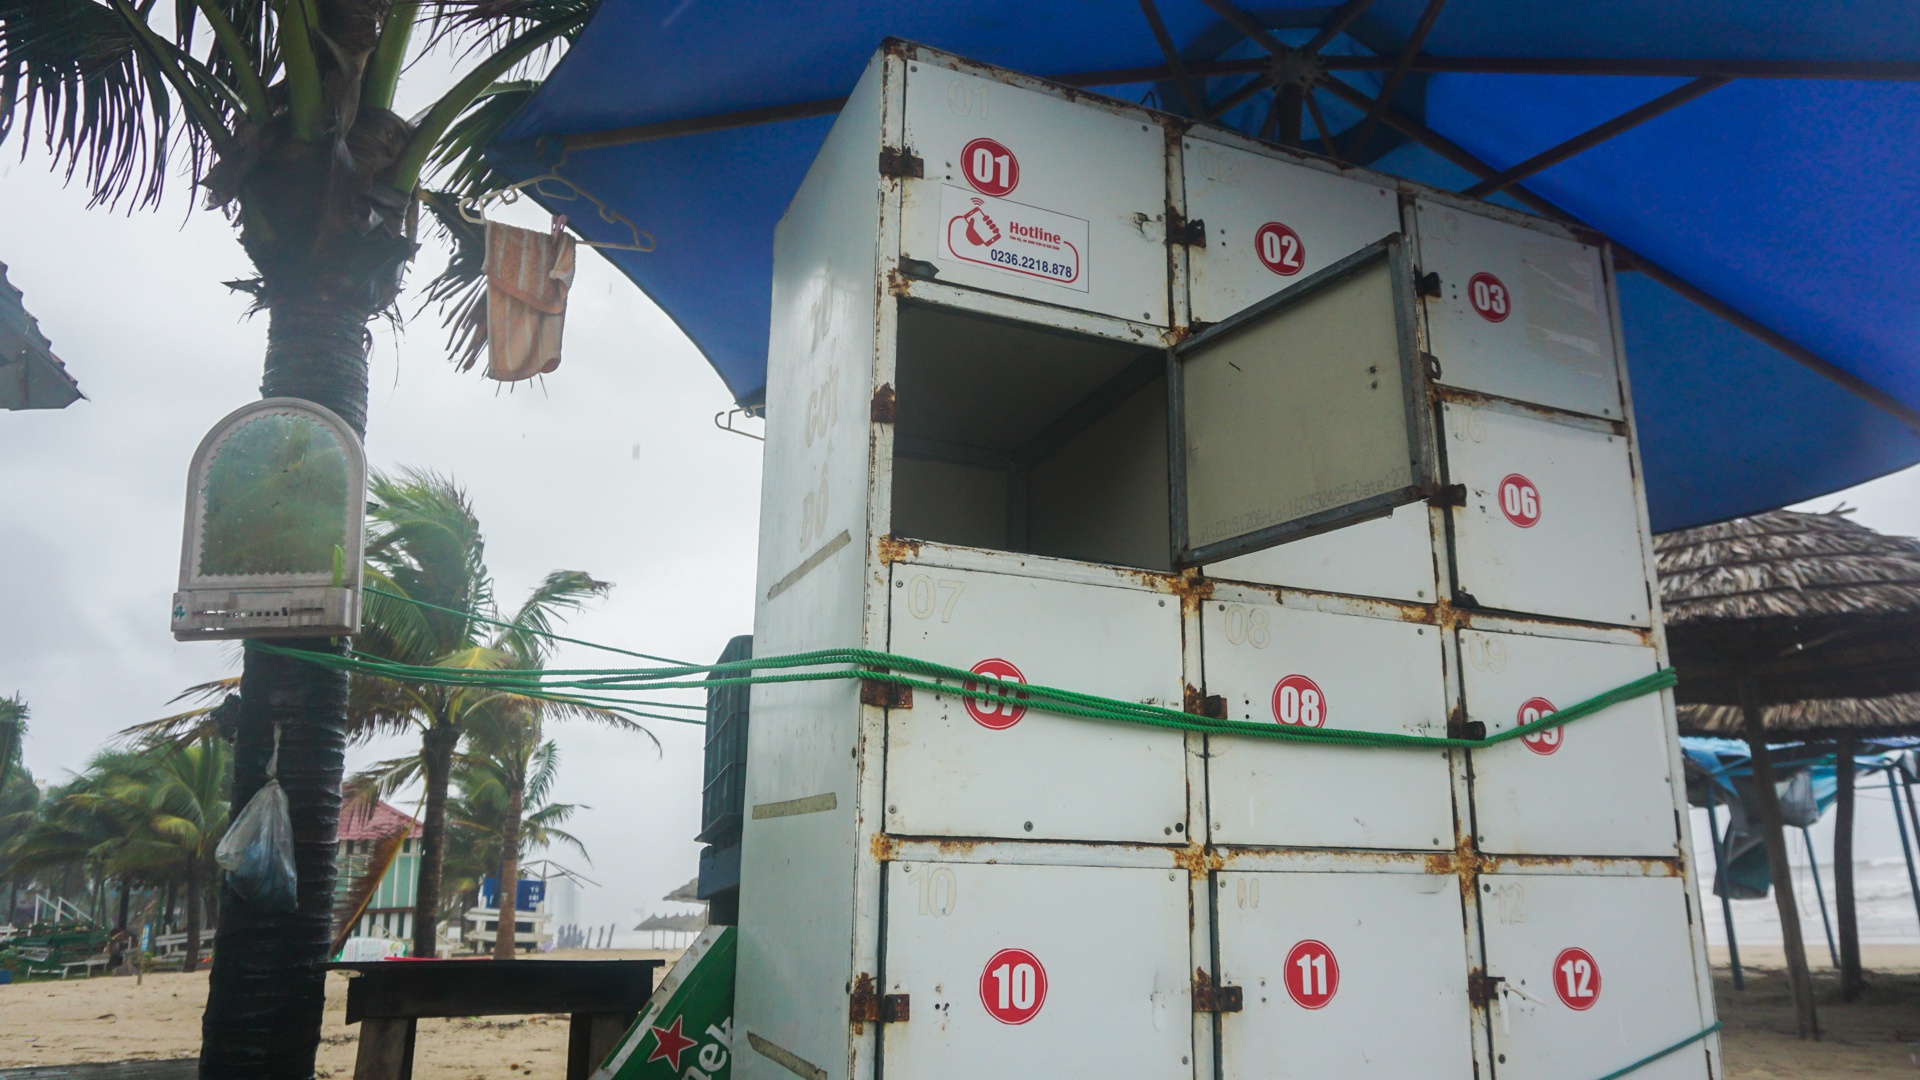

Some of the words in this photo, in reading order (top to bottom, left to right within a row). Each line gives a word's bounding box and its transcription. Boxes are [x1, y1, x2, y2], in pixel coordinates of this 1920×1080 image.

[973, 148, 1010, 188] 01
[1009, 221, 1061, 244] Hotline
[1262, 230, 1299, 268] 02
[990, 249, 1073, 278] 0236.2218.878
[1474, 279, 1507, 312] 03
[1505, 483, 1537, 518] 06
[908, 574, 966, 623] 07
[1225, 604, 1271, 649] 08
[1280, 685, 1321, 727] 08
[908, 864, 957, 917] 10
[992, 962, 1036, 1010] 10
[1296, 954, 1328, 996] 11
[1560, 959, 1594, 998] 12
